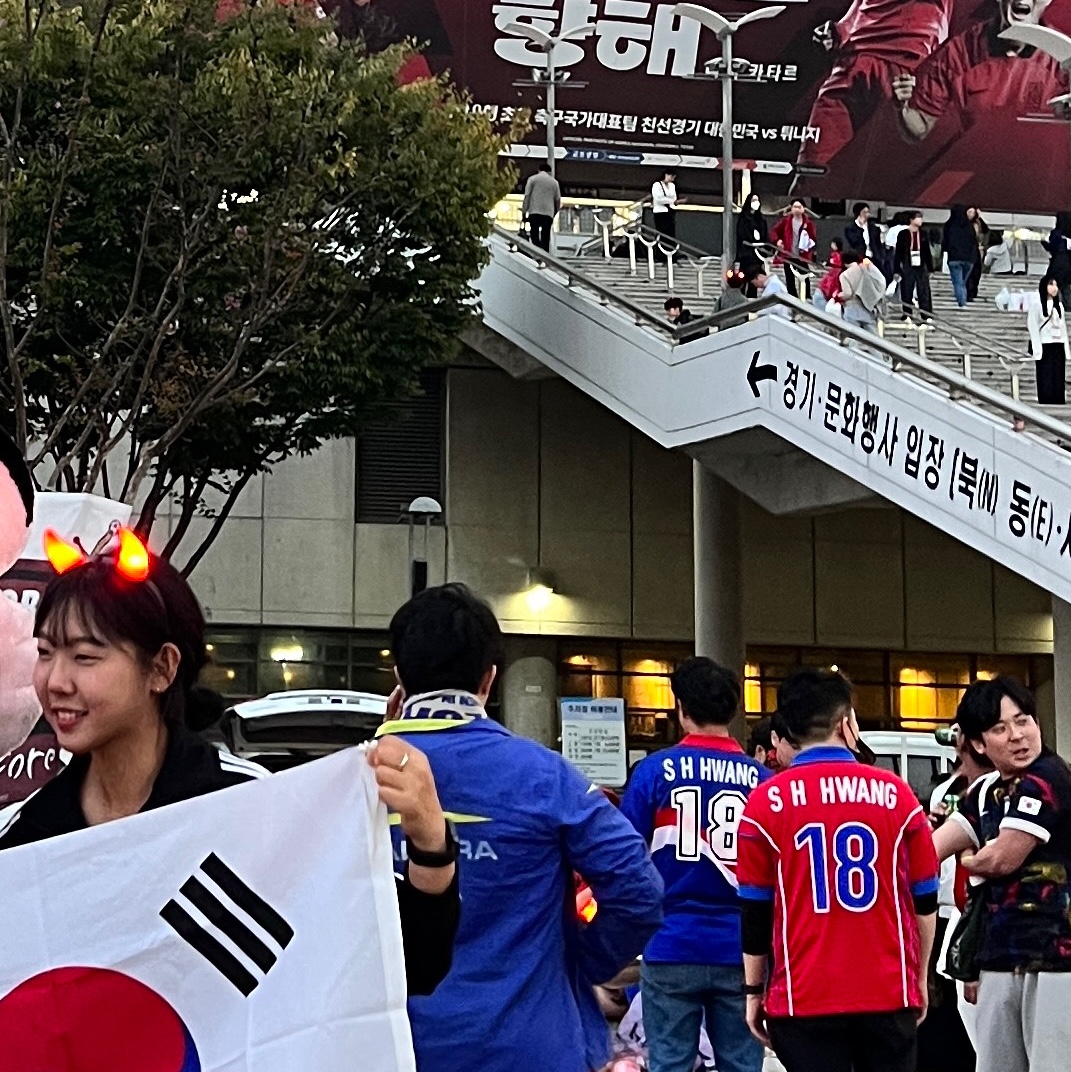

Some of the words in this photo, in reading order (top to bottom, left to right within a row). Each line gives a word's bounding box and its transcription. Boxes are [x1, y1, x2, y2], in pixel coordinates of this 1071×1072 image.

[641, 115, 702, 137] 친선경기
[761, 127, 778, 140] vs
[780, 125, 821, 143] 튀니지
[904, 425, 946, 491] 입장
[663, 758, 676, 782] S
[680, 756, 694, 780] H
[700, 756, 759, 789] HWANG
[767, 785, 784, 812] S
[790, 779, 807, 806] H
[820, 775, 898, 810] HWANG
[671, 785, 749, 866] 18
[794, 821, 879, 914] 18
